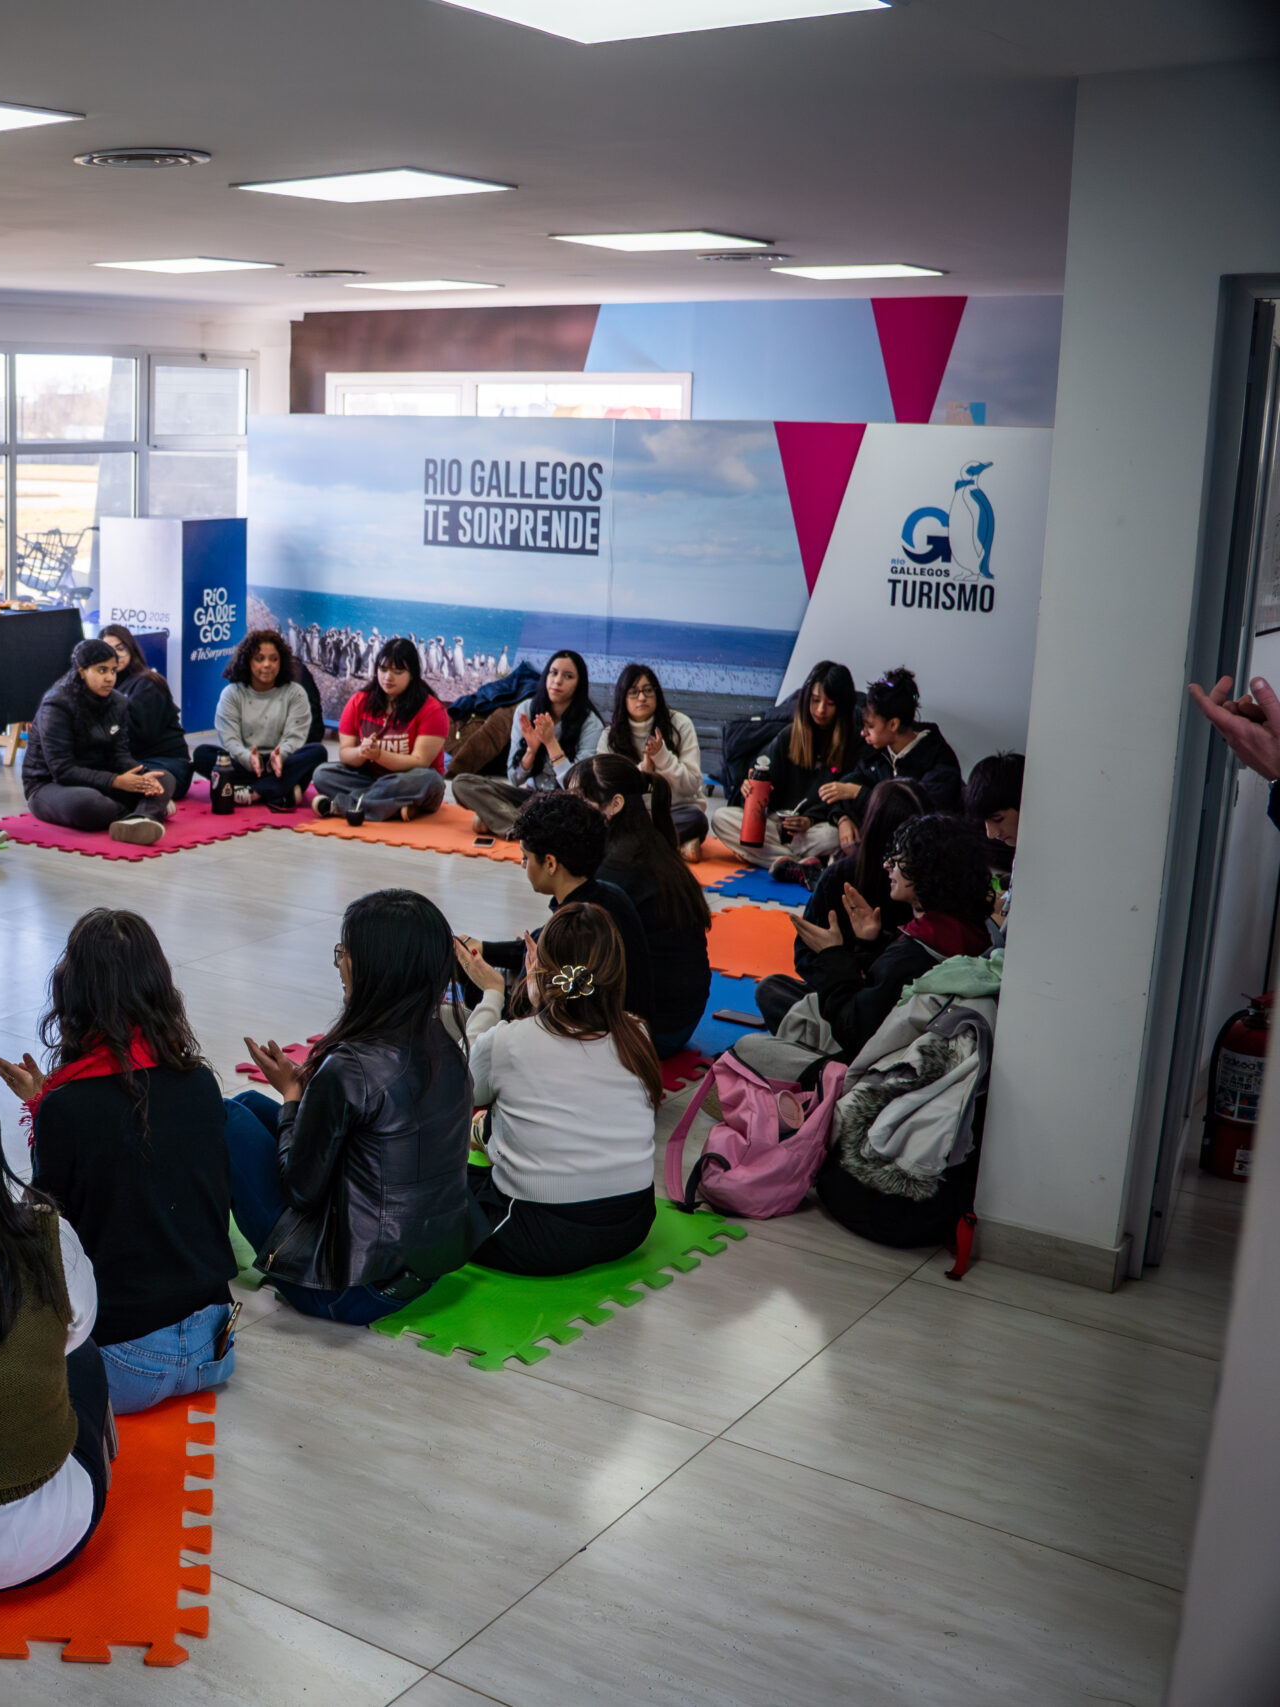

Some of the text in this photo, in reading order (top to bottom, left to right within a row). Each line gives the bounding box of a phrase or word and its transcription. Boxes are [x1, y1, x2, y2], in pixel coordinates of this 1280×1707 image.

[424, 458, 604, 502] RIO GALLEGOS
[424, 504, 600, 551] TE SORPRENDE
[890, 566, 951, 578] GALLEGOS
[887, 578, 996, 614] TURISMO
[111, 608, 171, 623] EXPO 2025
[199, 623, 232, 643] GOS
